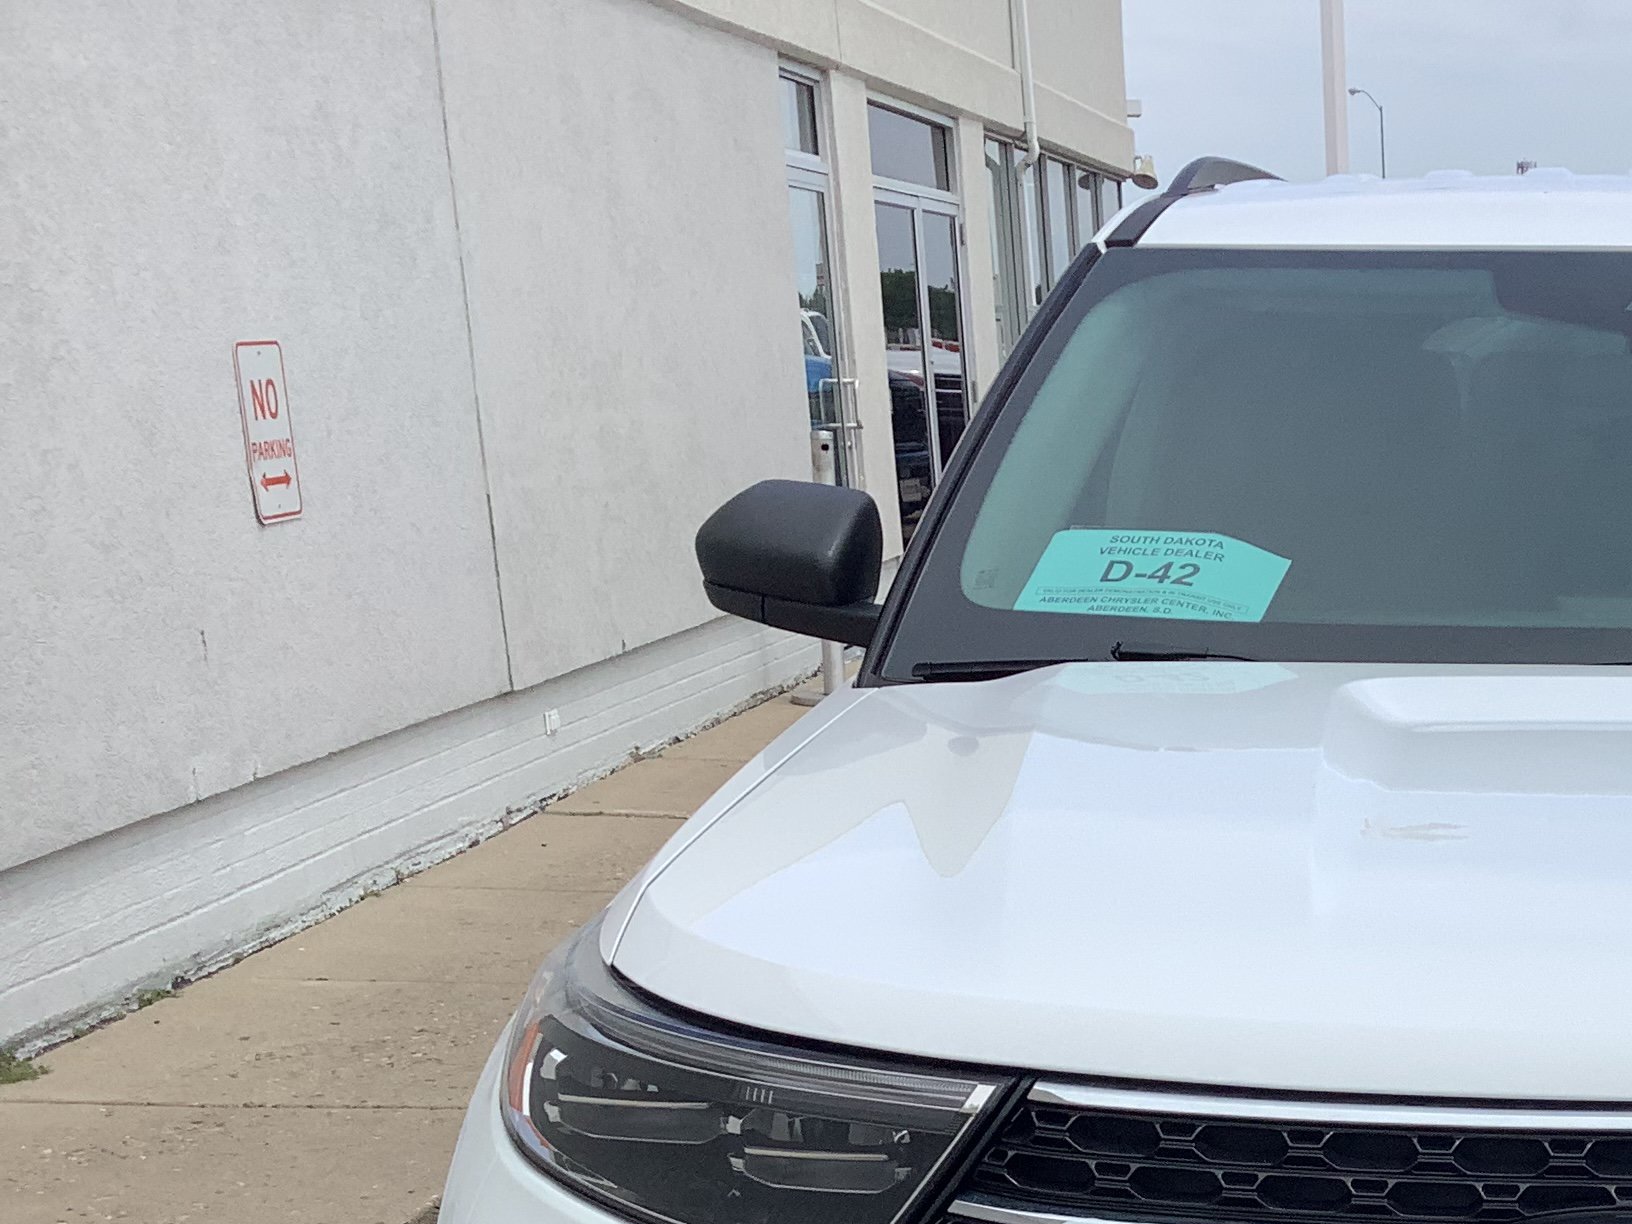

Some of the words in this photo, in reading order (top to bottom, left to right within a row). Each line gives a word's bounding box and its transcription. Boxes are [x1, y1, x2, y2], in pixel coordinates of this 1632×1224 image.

[250, 378, 279, 421] NO
[251, 438, 293, 462] PARKING
[1110, 535, 1161, 545] SOUTH
[1163, 536, 1224, 549] DAKOTA
[1100, 546, 1160, 557] VEHICLE
[1163, 548, 1225, 562] DEALER
[1099, 559, 1201, 587] D-42
[1039, 596, 1097, 604] ABERDEEN
[1100, 596, 1159, 605] CHRYSLER
